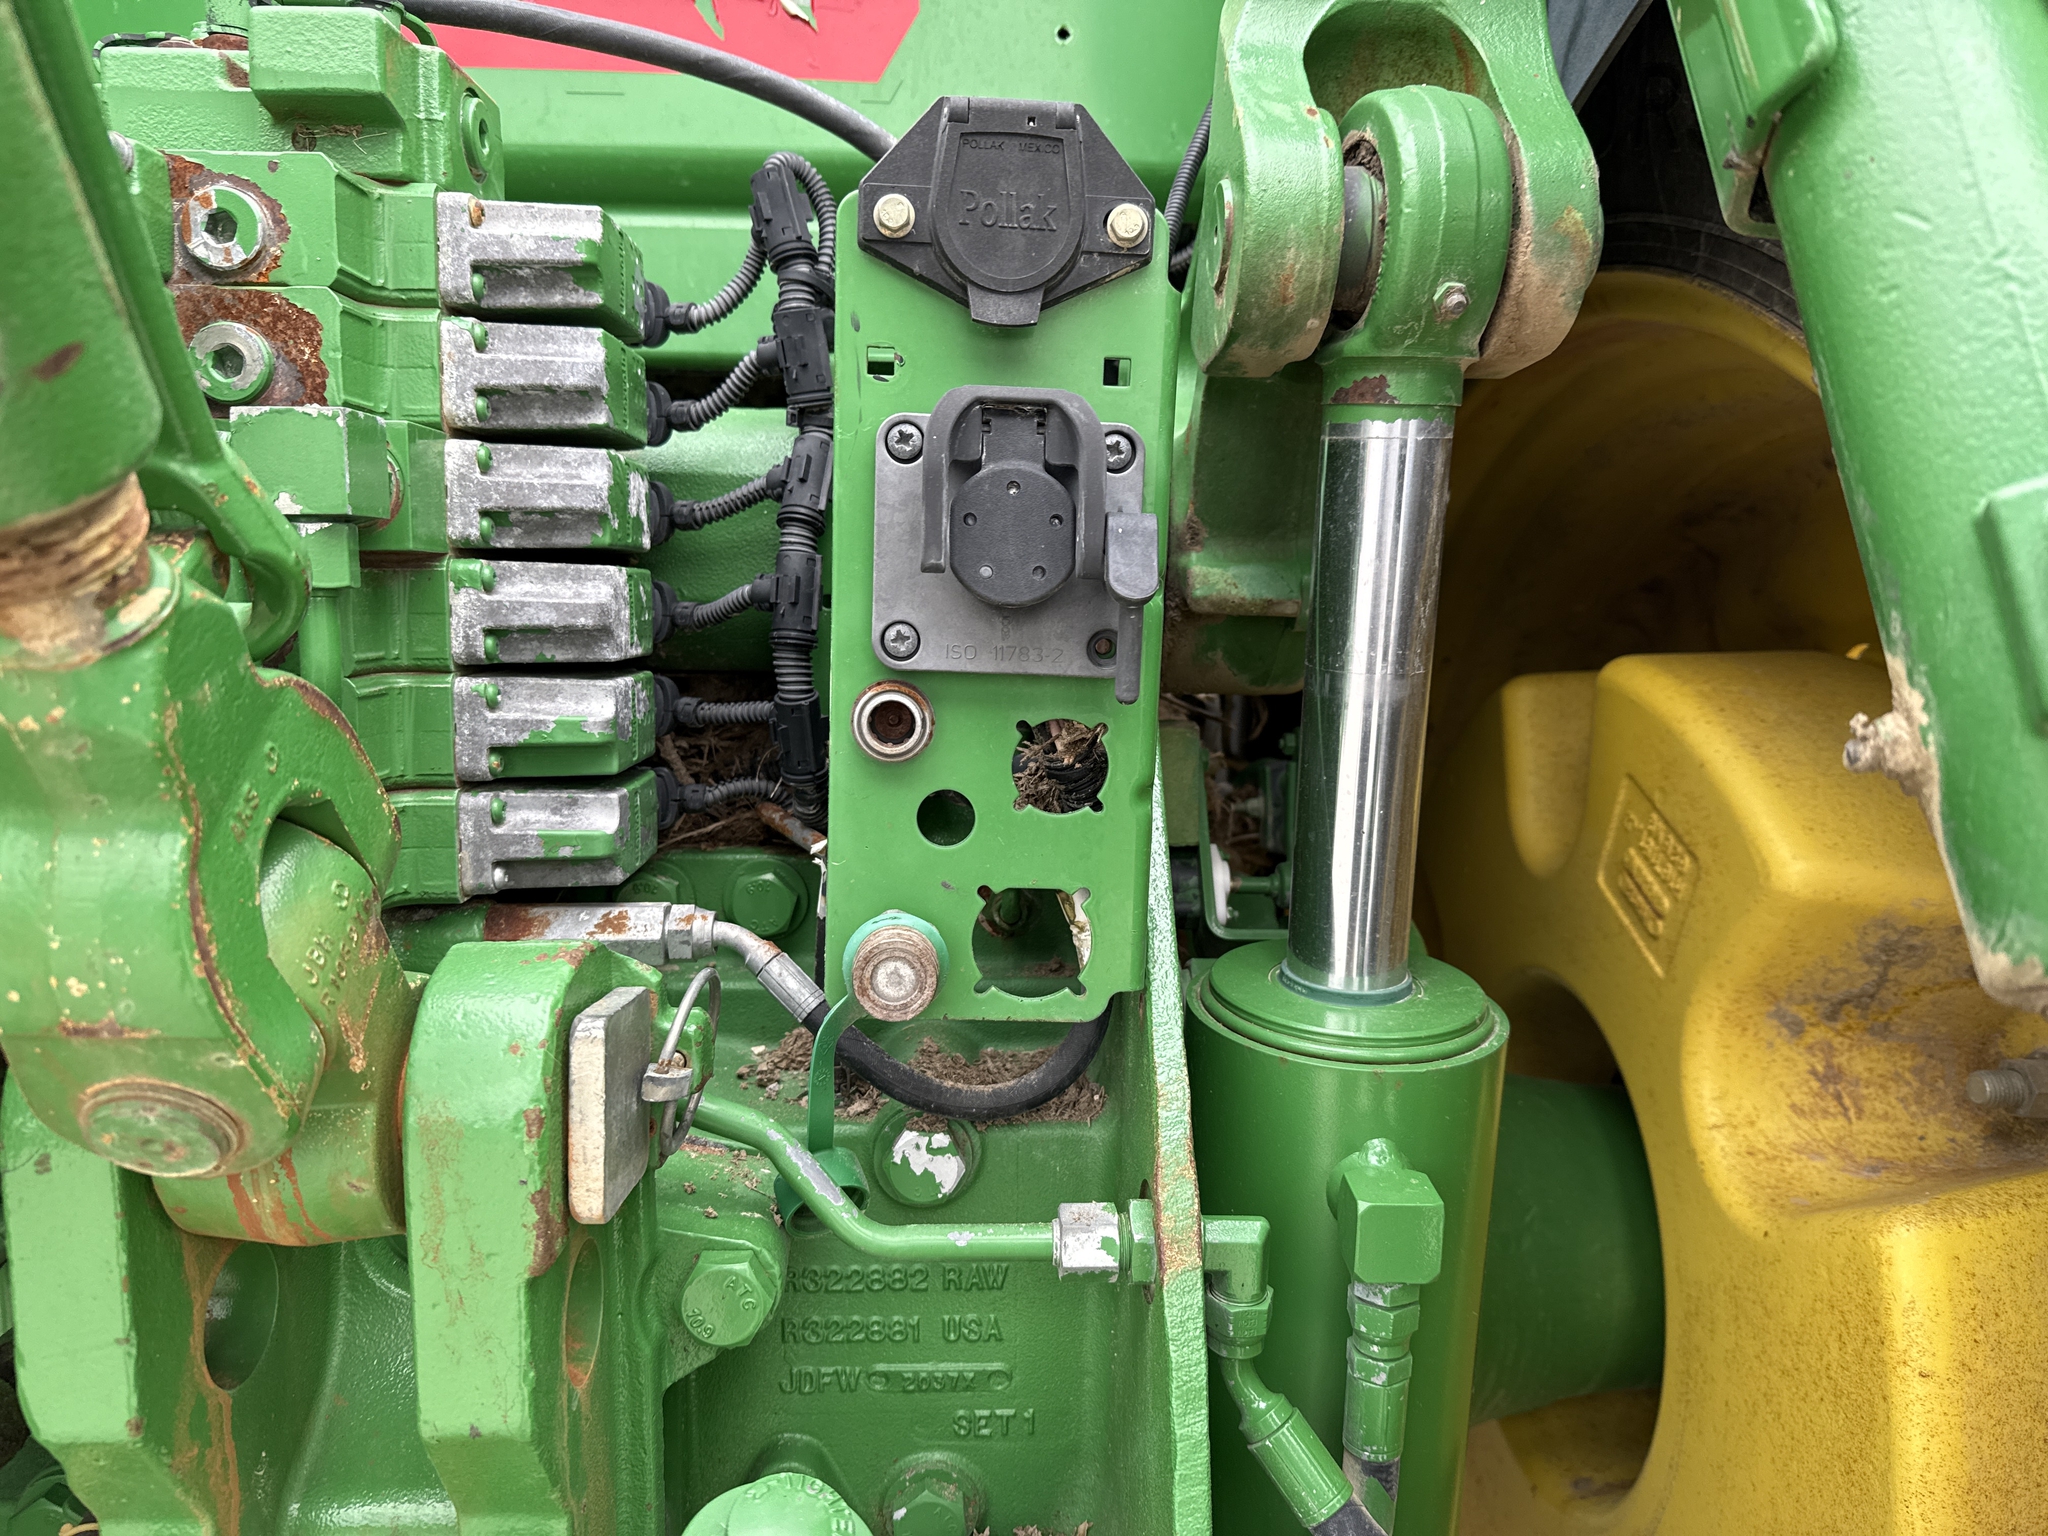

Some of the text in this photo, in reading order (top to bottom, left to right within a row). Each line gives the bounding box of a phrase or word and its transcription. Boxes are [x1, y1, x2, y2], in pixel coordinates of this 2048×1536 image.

[961, 137, 1005, 152] POLLAK
[958, 189, 1058, 232] Pollak
[945, 642, 1065, 664] ISO 11783-2
[723, 1275, 758, 1312] ATC
[784, 1262, 1010, 1294] R322882 RAW
[781, 1313, 1005, 1344] R322881 USA
[778, 1366, 862, 1395] JDFW
